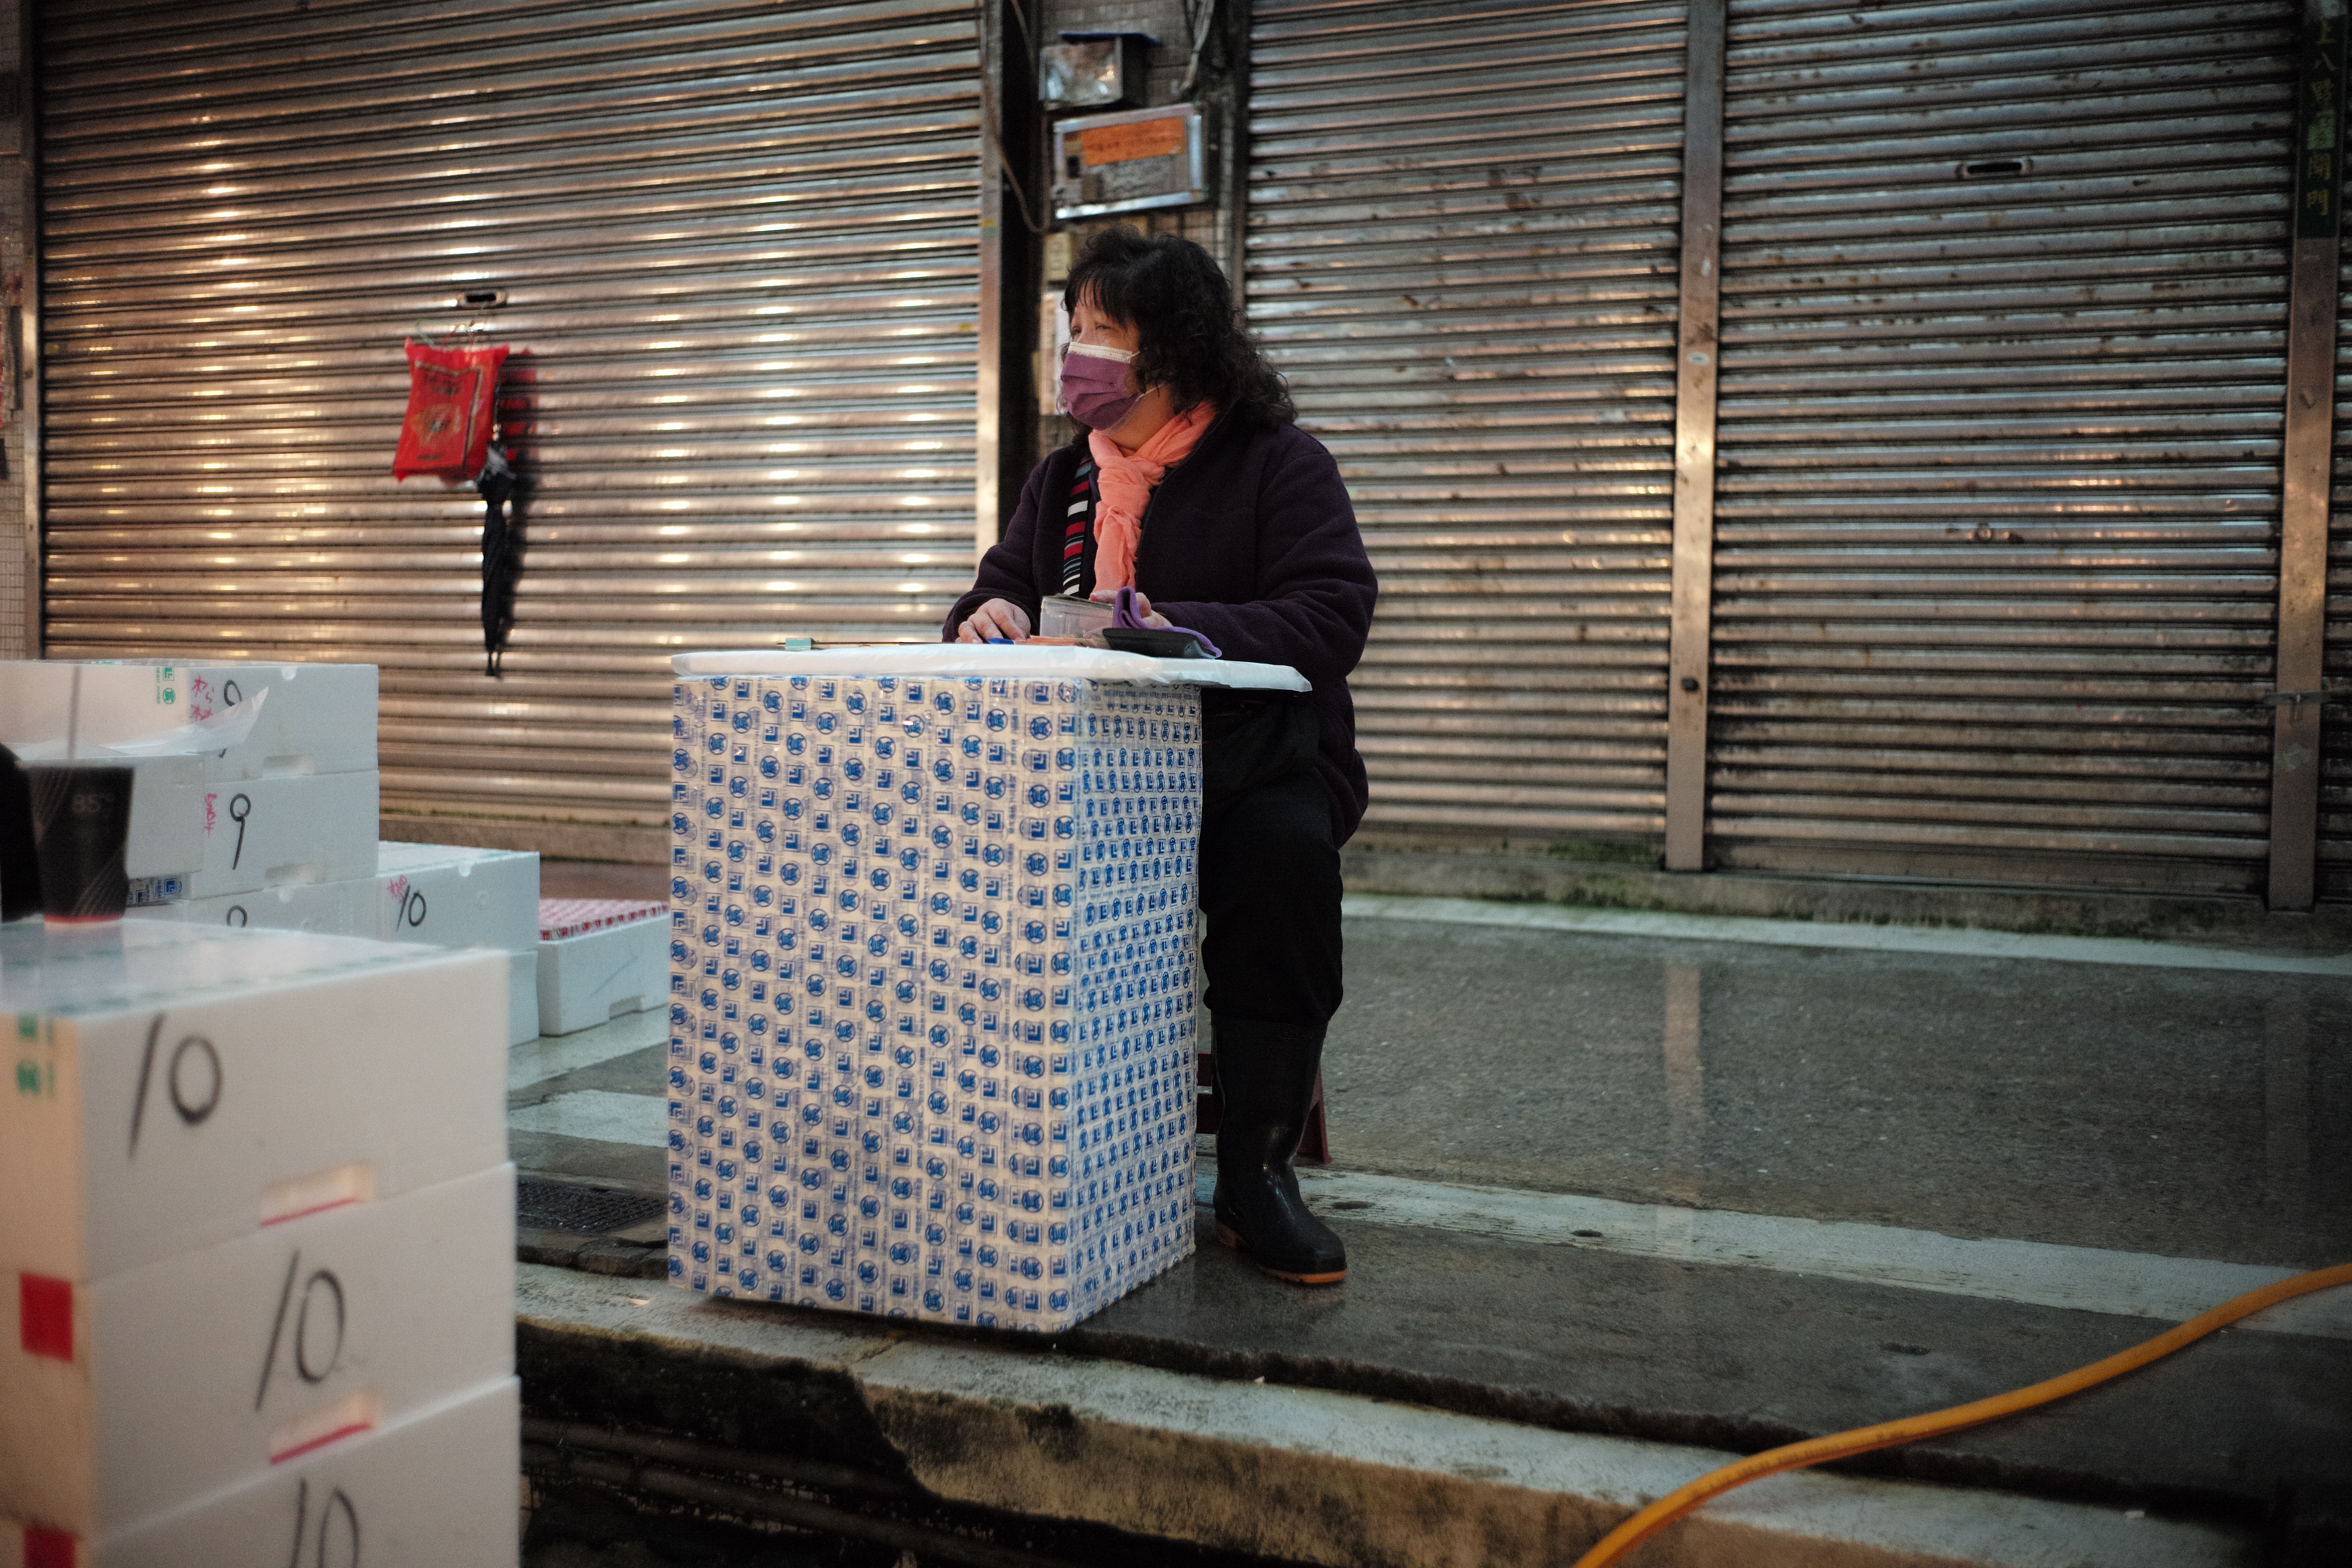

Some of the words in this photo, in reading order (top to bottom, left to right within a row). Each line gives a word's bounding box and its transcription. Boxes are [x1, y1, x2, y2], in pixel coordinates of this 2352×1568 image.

[230, 793, 251, 870] 9
[396, 884, 427, 933] 10
[128, 1012, 224, 1159] 10
[255, 1250, 345, 1412] 10
